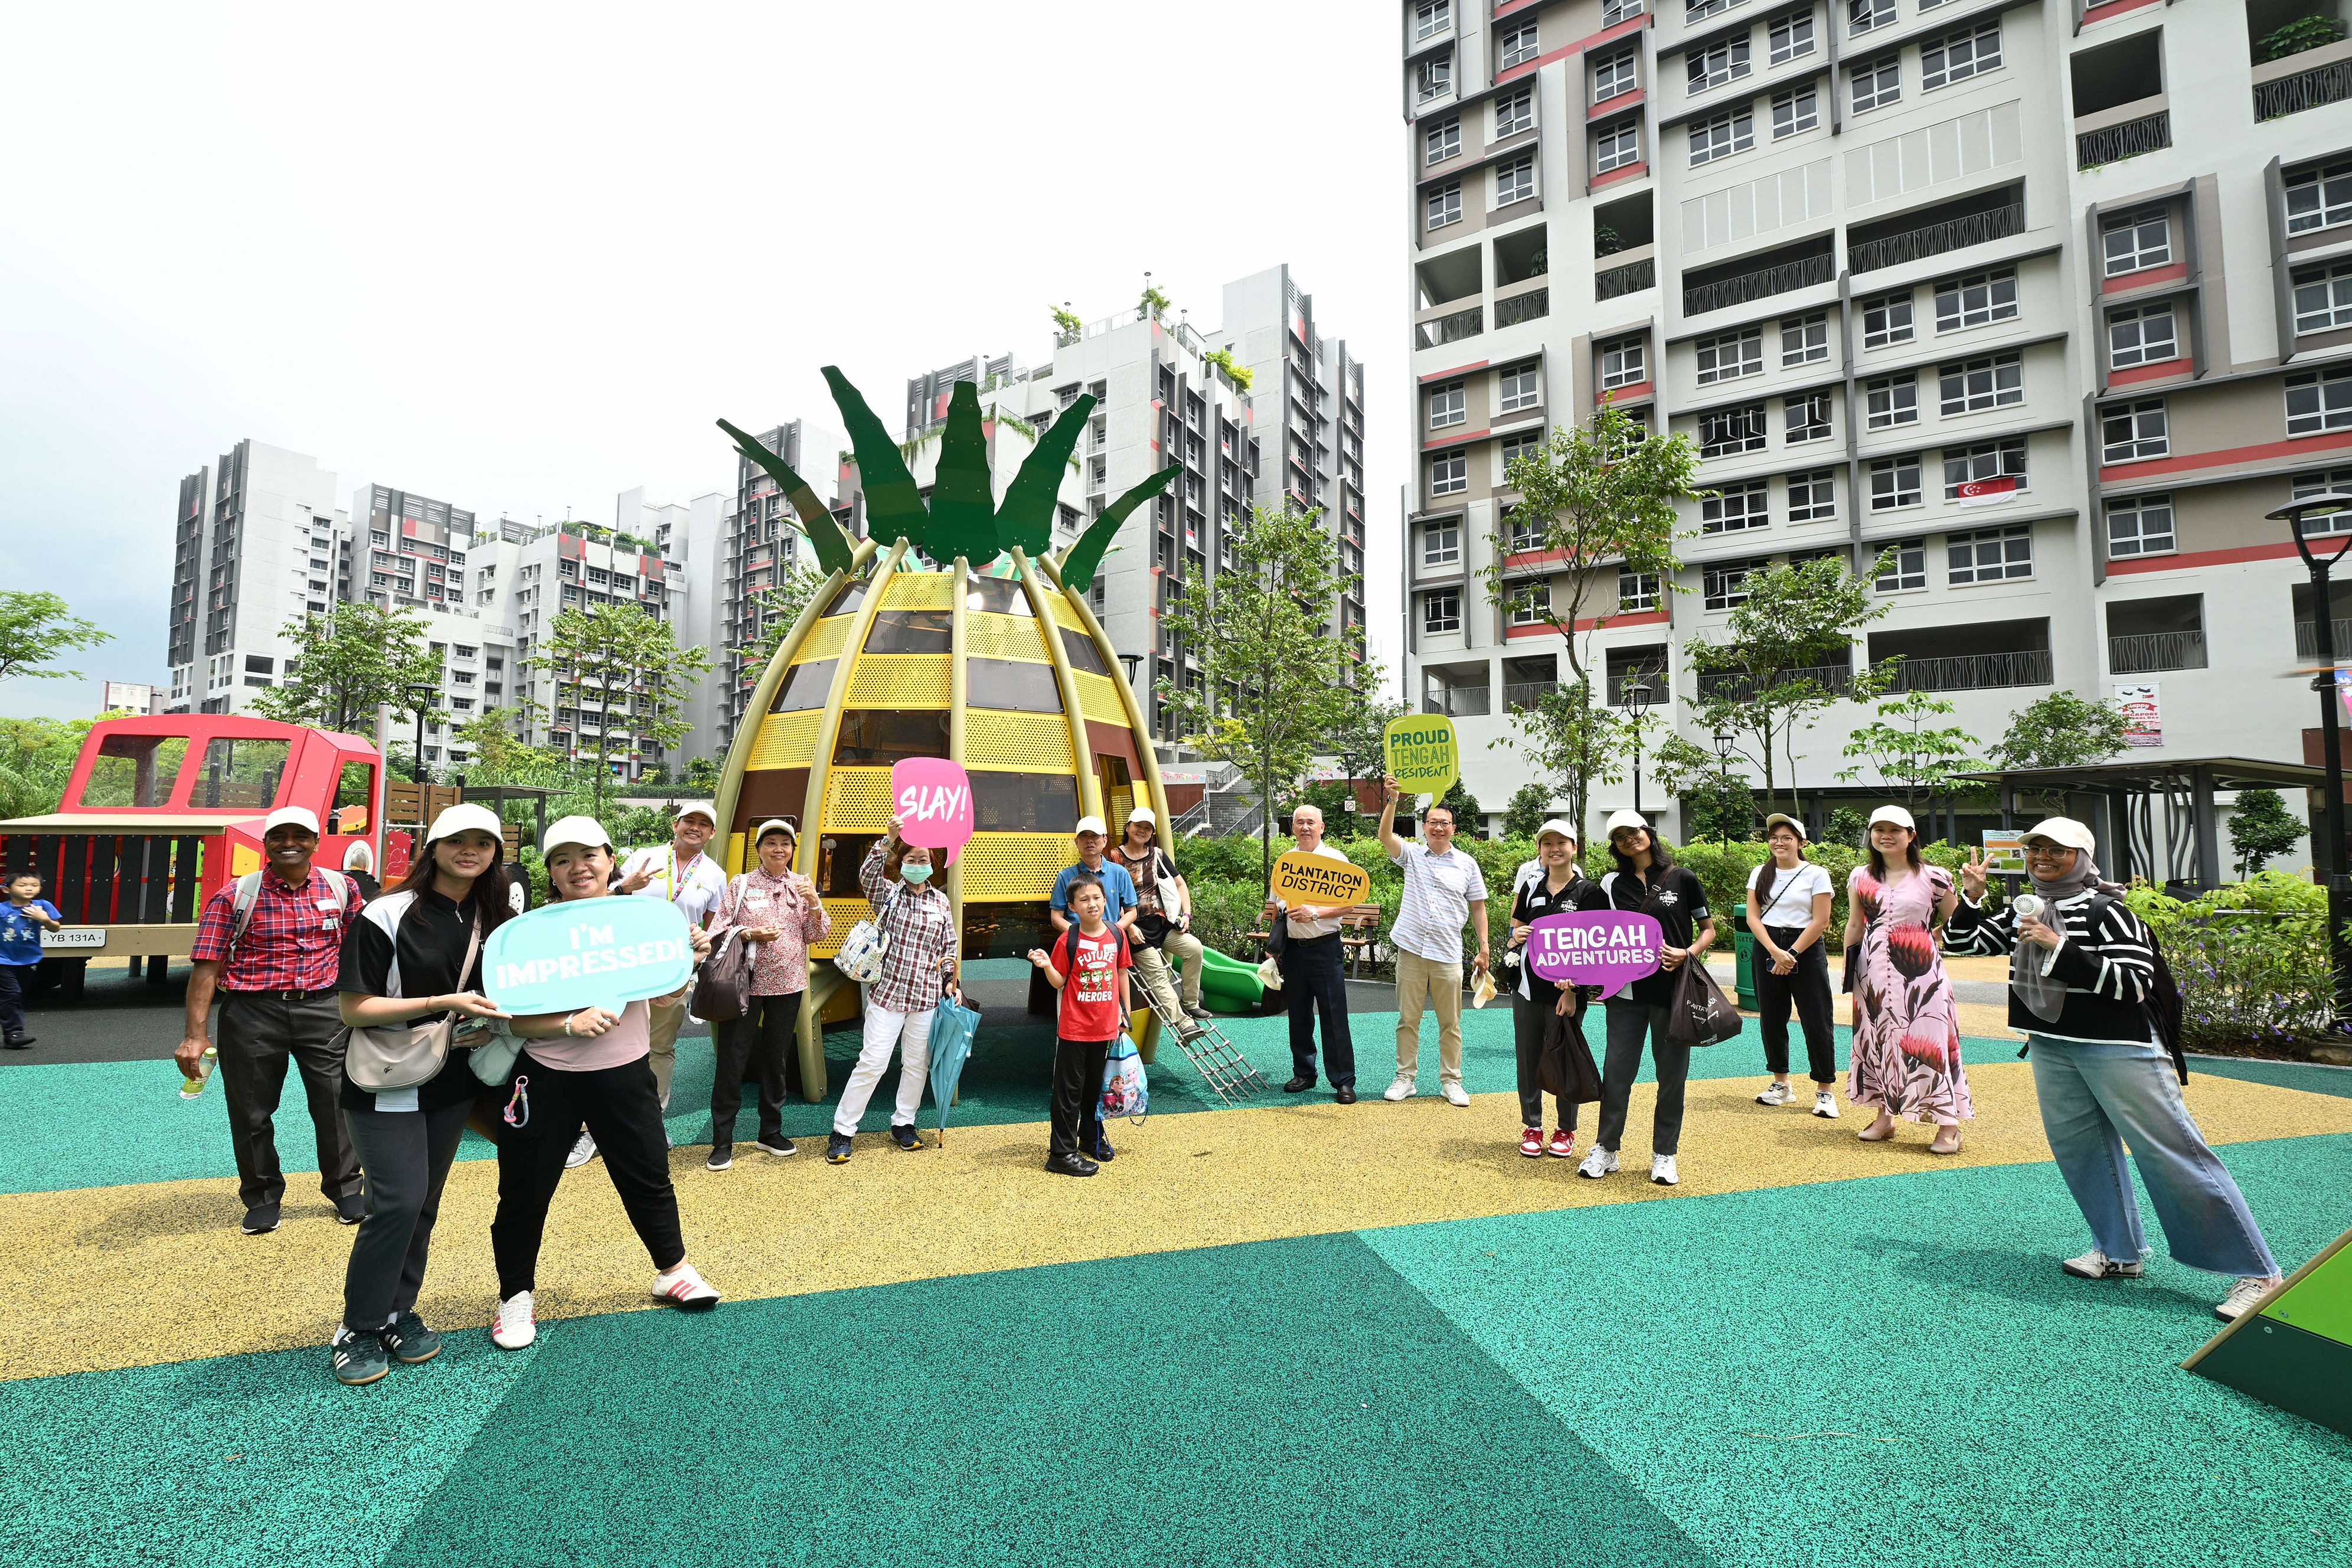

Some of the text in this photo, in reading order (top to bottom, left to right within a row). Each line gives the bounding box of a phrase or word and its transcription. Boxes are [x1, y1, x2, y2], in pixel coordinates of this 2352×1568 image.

[1390, 729, 1449, 748] PROUD
[1391, 745, 1449, 767] TENGAH
[1394, 765, 1450, 779] RESIDENT
[899, 784, 968, 822] SLAY!
[1280, 862, 1362, 887] PLANTATION
[1281, 876, 1357, 899] DISTRICT
[569, 923, 615, 950] I'M
[495, 937, 687, 989] IMPRESSED!
[1077, 950, 1115, 966] FUTURE
[1536, 949, 1655, 966] ADVENTURES
[1077, 991, 1112, 1002] HEROES
